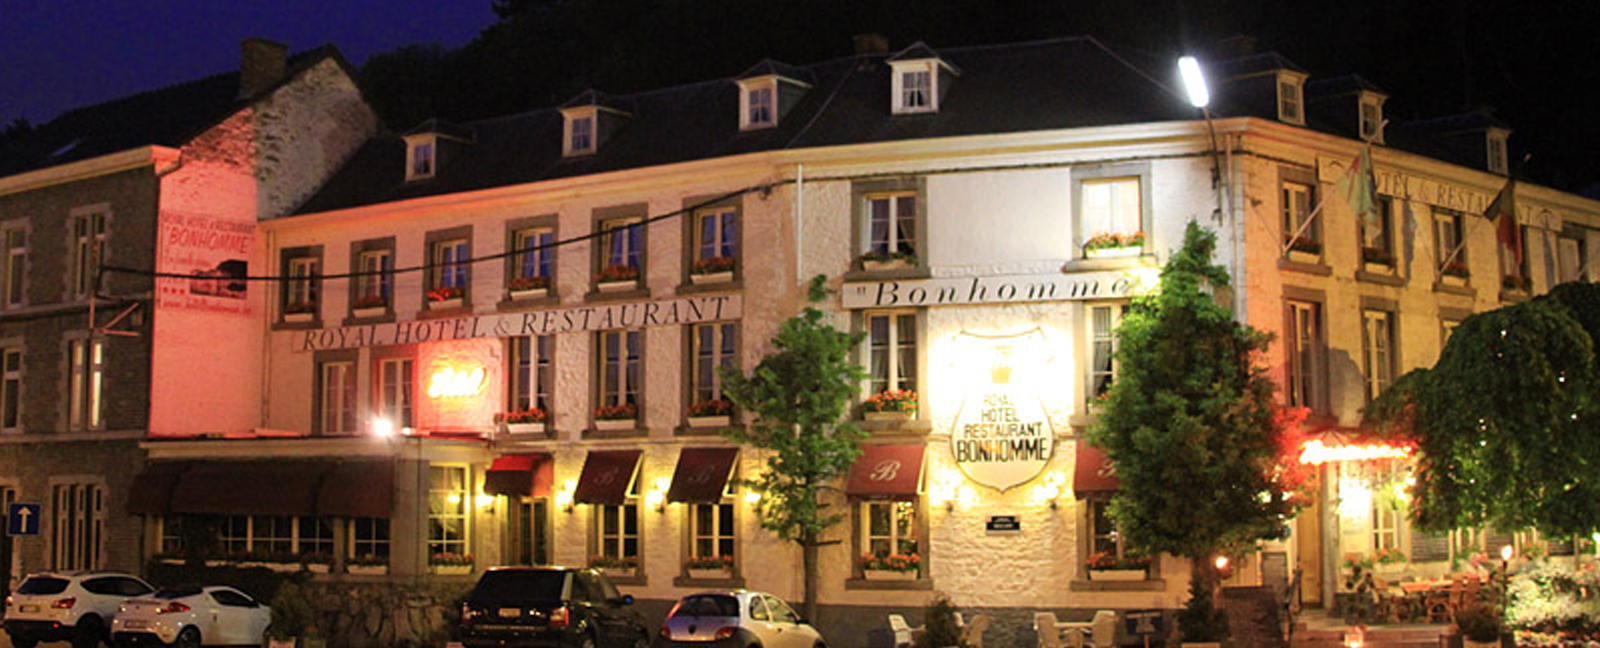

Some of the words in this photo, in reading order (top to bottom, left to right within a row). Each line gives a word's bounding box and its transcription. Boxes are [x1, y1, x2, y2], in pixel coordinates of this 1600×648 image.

[302, 323, 383, 351] ROYAL
[393, 316, 486, 344] HOTEL
[493, 318, 511, 337] &
[520, 296, 730, 336] RESTAURANT
[981, 407, 1020, 422] HOTEL
[963, 421, 1043, 439] RESTAURANT
[956, 437, 1049, 463] BONHOMME
[869, 460, 901, 481] B
